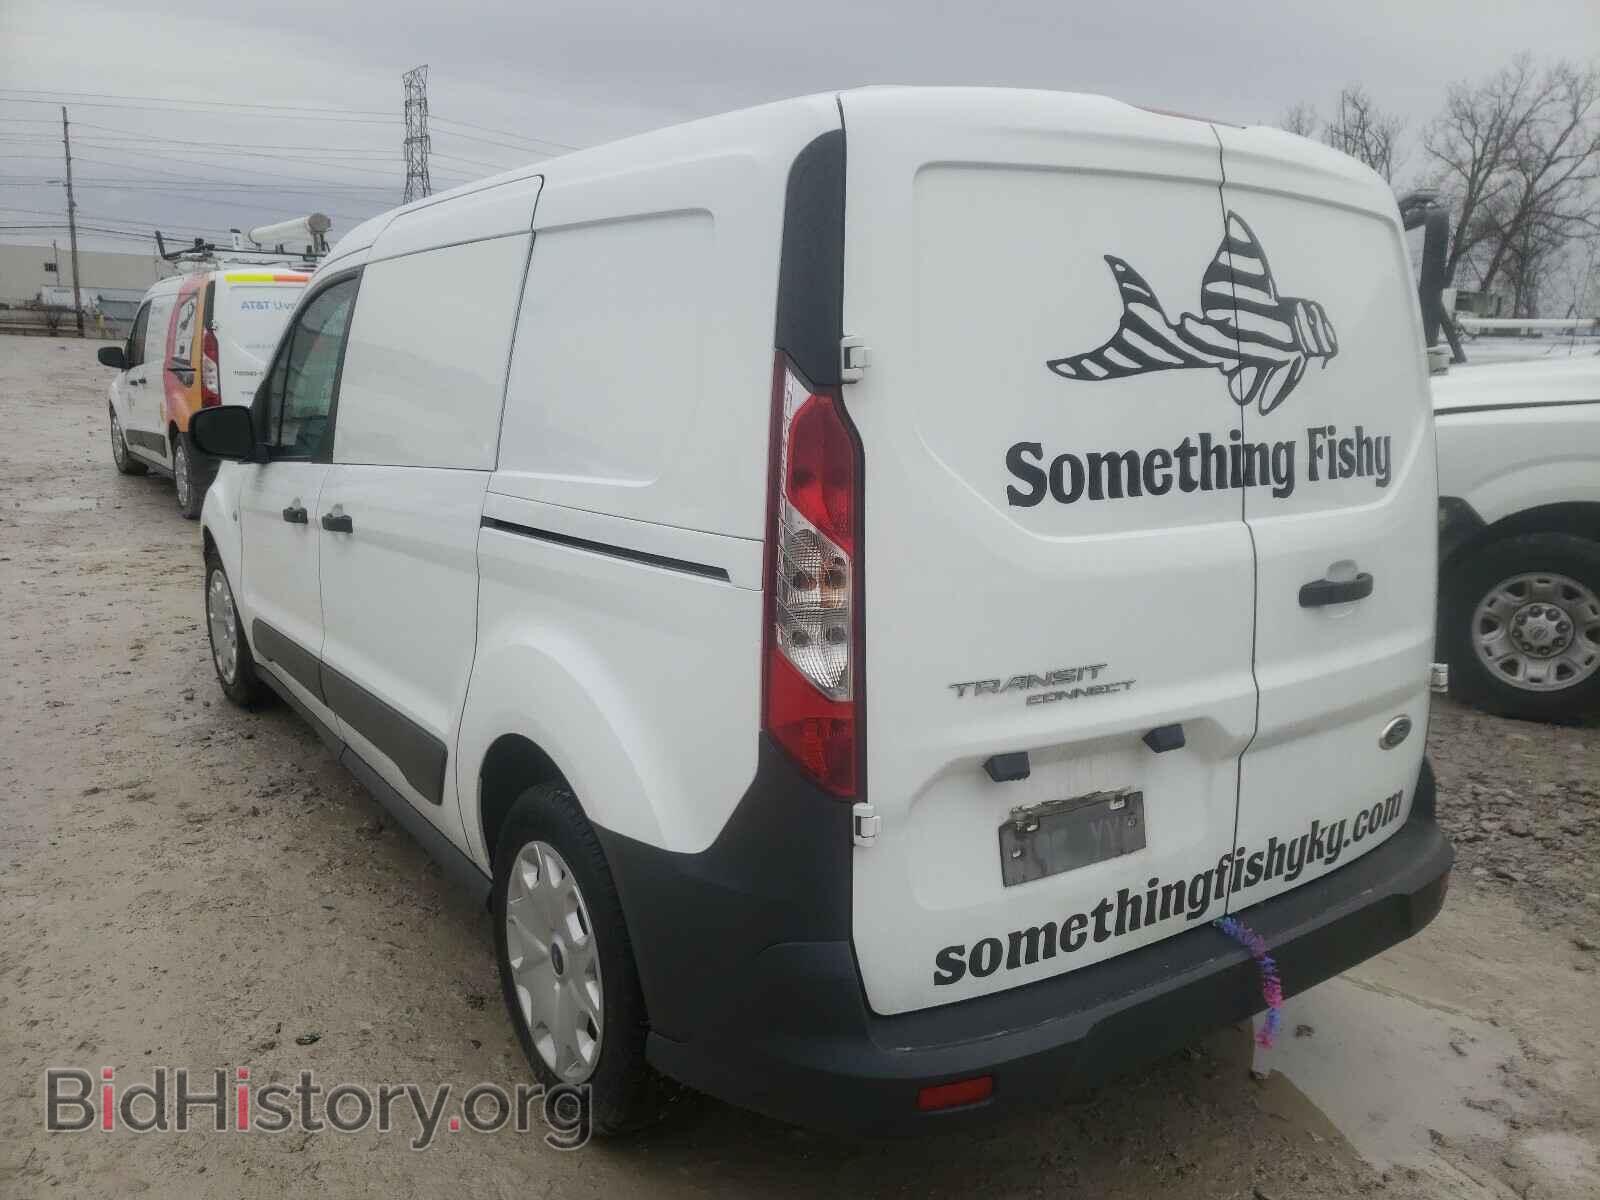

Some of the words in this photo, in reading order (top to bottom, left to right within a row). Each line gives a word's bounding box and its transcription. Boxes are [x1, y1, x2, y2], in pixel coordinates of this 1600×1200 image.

[1005, 429, 1297, 508] Something
[1307, 425, 1392, 488] Fishy
[949, 663, 1107, 697] TRANSIT
[1026, 680, 1136, 706] CONNECT
[933, 789, 1404, 986] somethingfishyky.com
